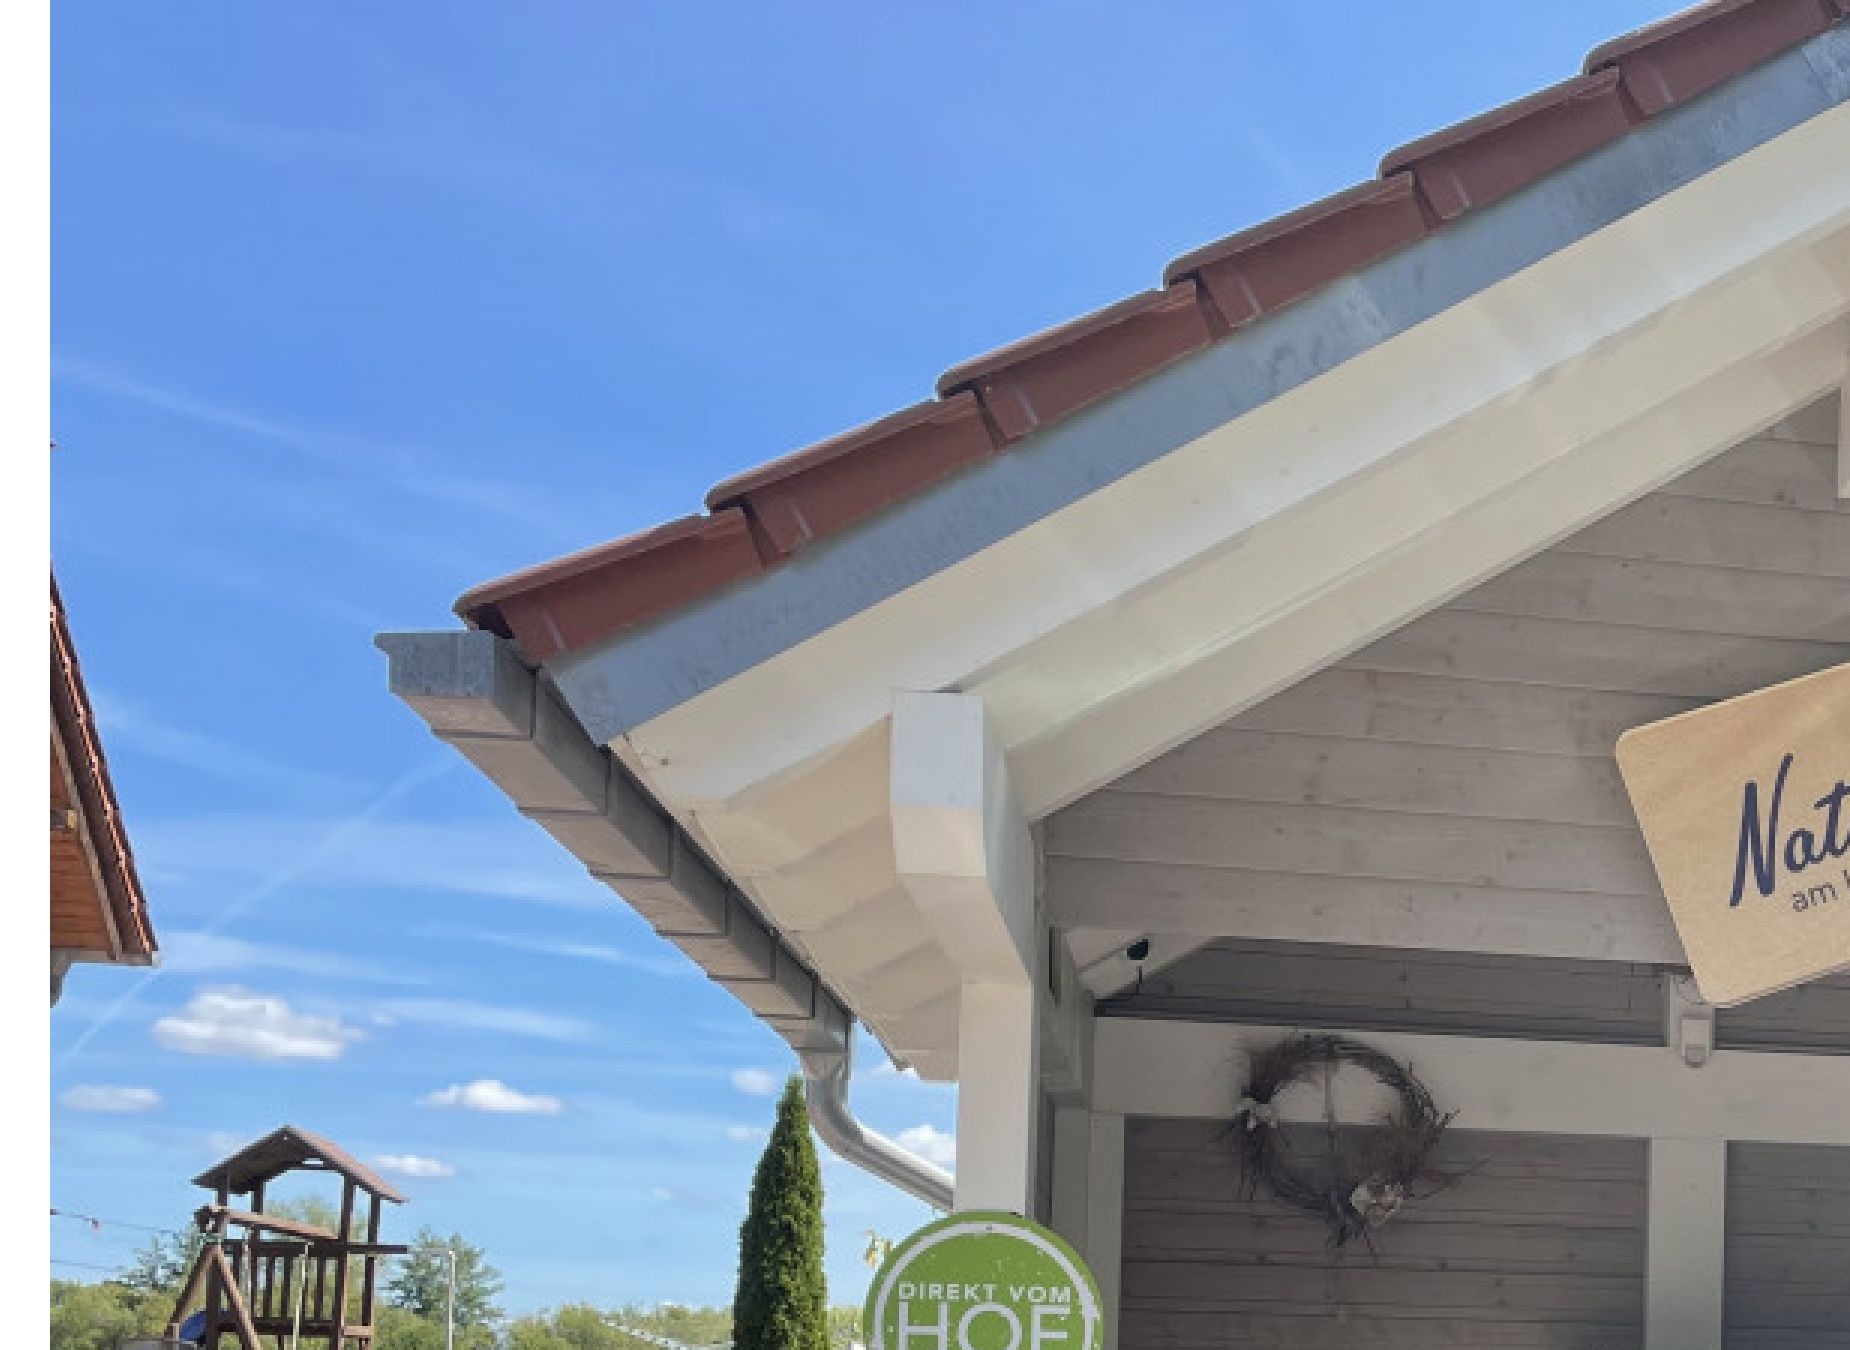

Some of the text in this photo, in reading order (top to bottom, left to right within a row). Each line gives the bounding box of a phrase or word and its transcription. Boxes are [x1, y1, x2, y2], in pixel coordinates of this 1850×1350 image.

[1791, 879, 1837, 913] am
[898, 1281, 1071, 1303] DIREKT VOM
